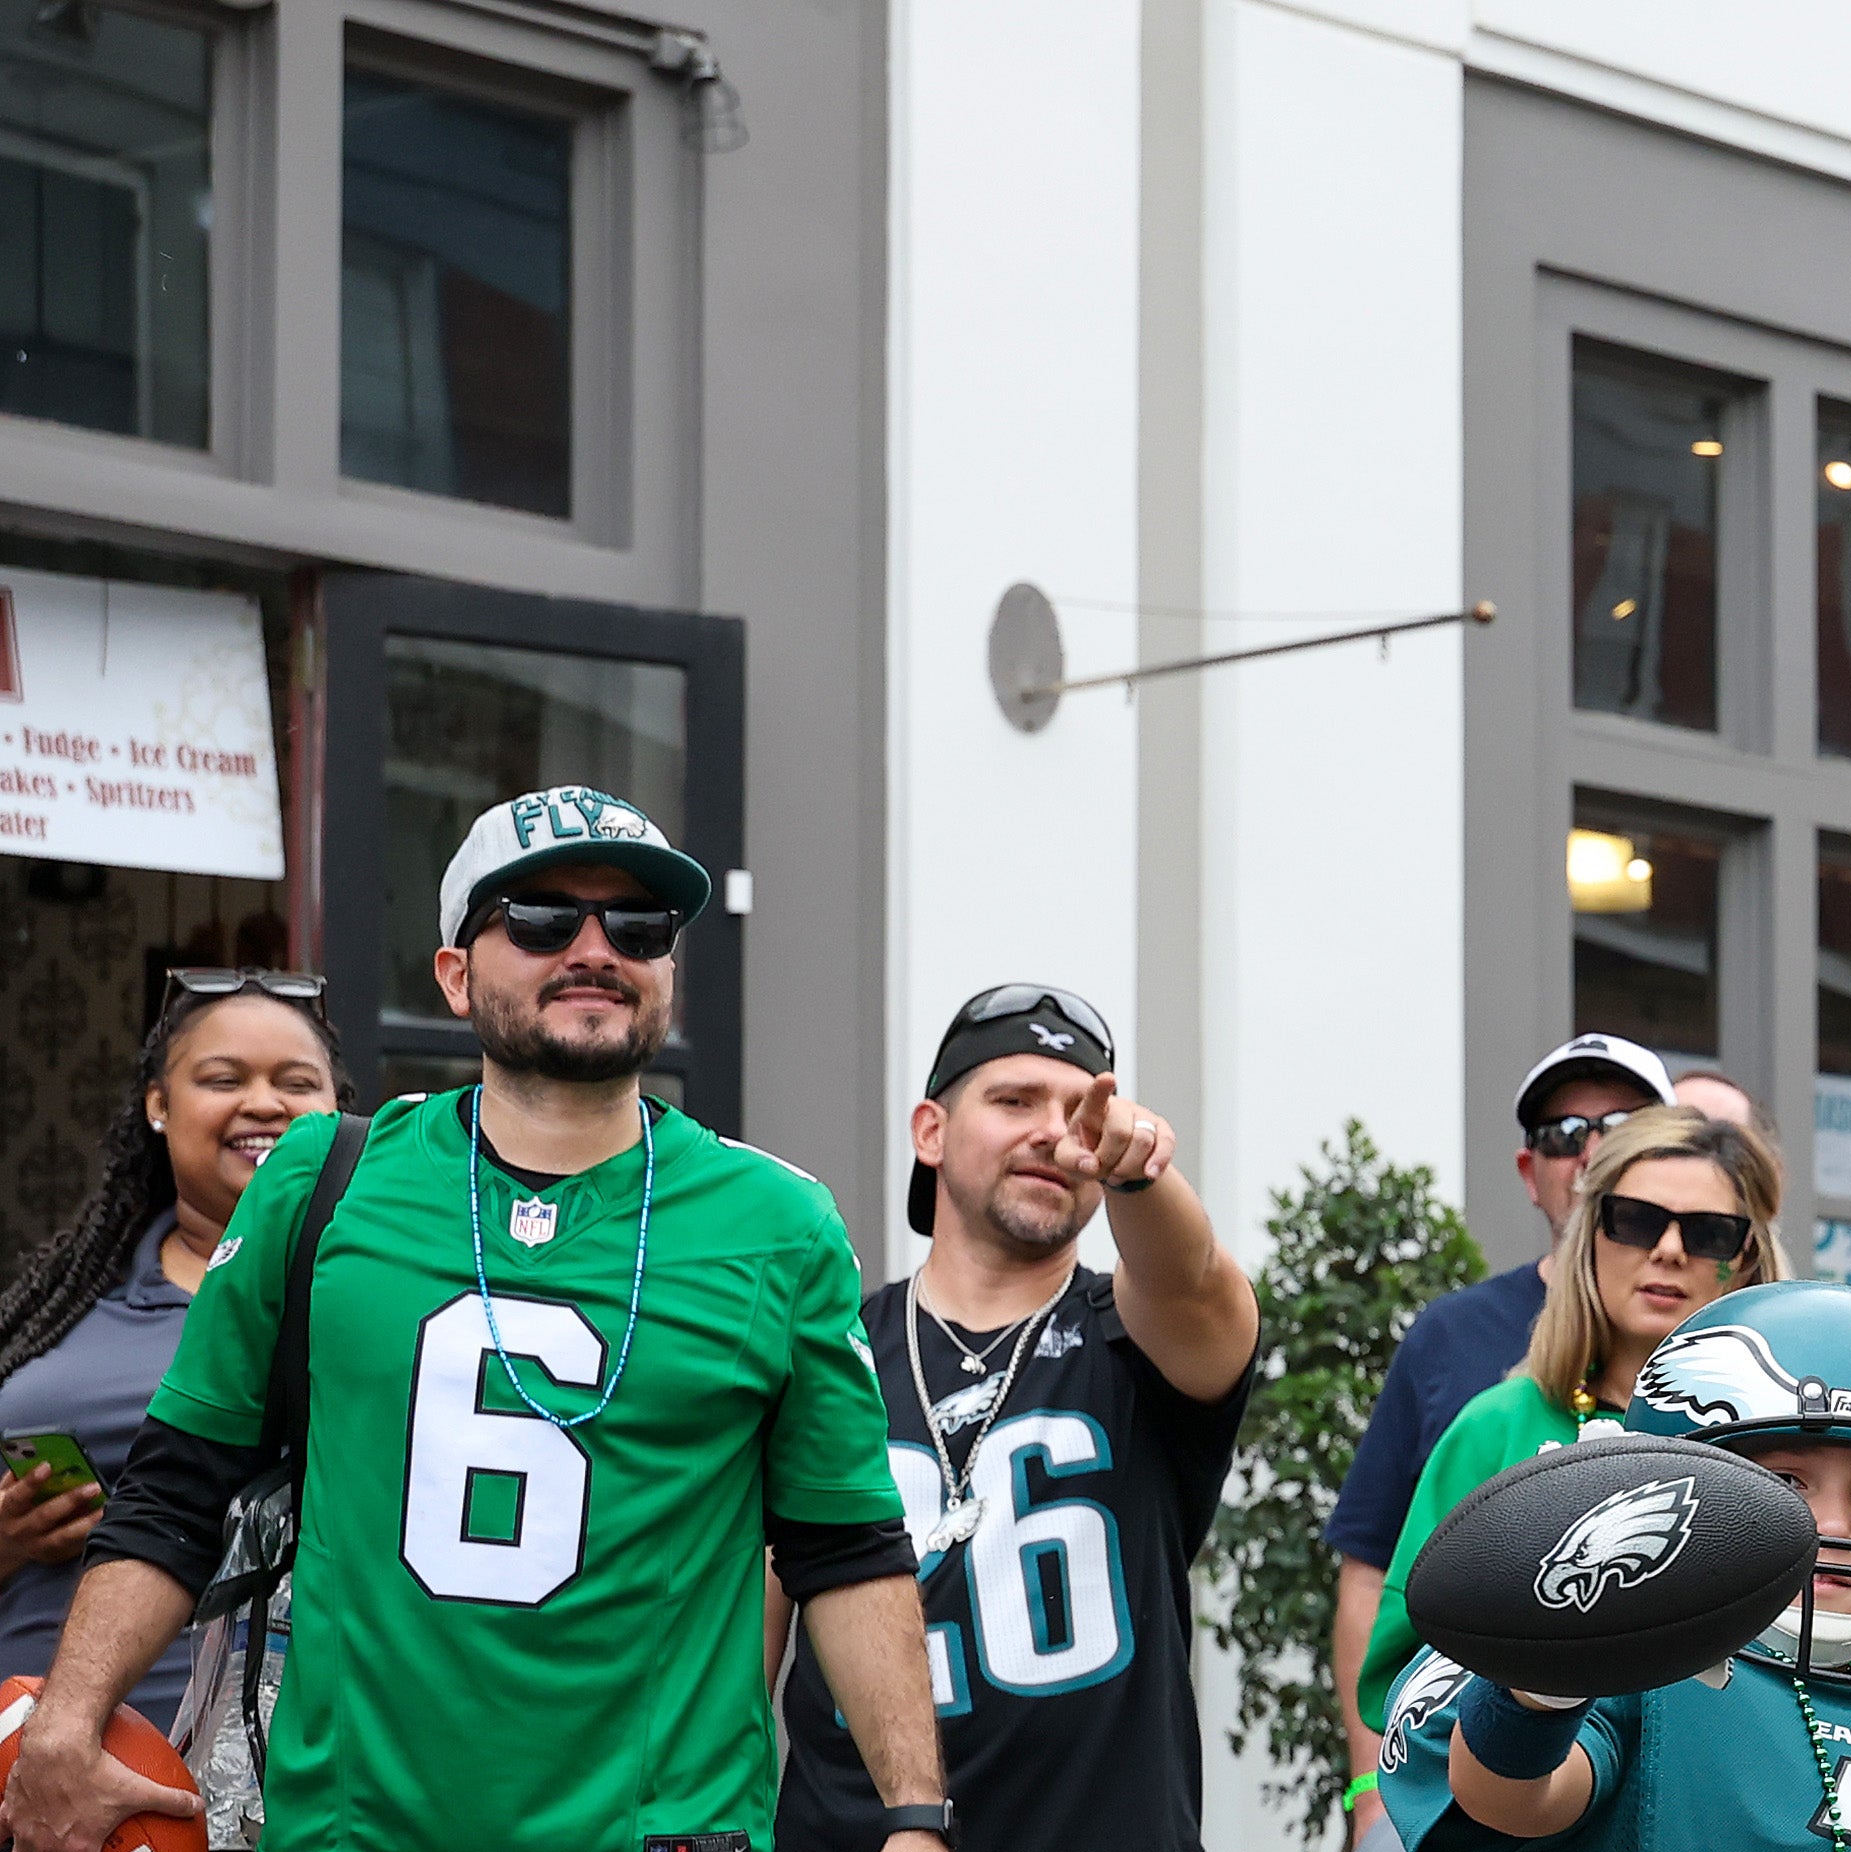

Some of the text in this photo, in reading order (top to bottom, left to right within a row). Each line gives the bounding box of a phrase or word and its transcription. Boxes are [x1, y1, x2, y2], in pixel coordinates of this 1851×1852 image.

[23, 725, 257, 777] Fudge Ice Cream
[85, 776, 196, 814] Spritzers
[513, 799, 604, 849] FLY
[518, 1219, 547, 1238] NFL
[400, 1290, 608, 1600] 6
